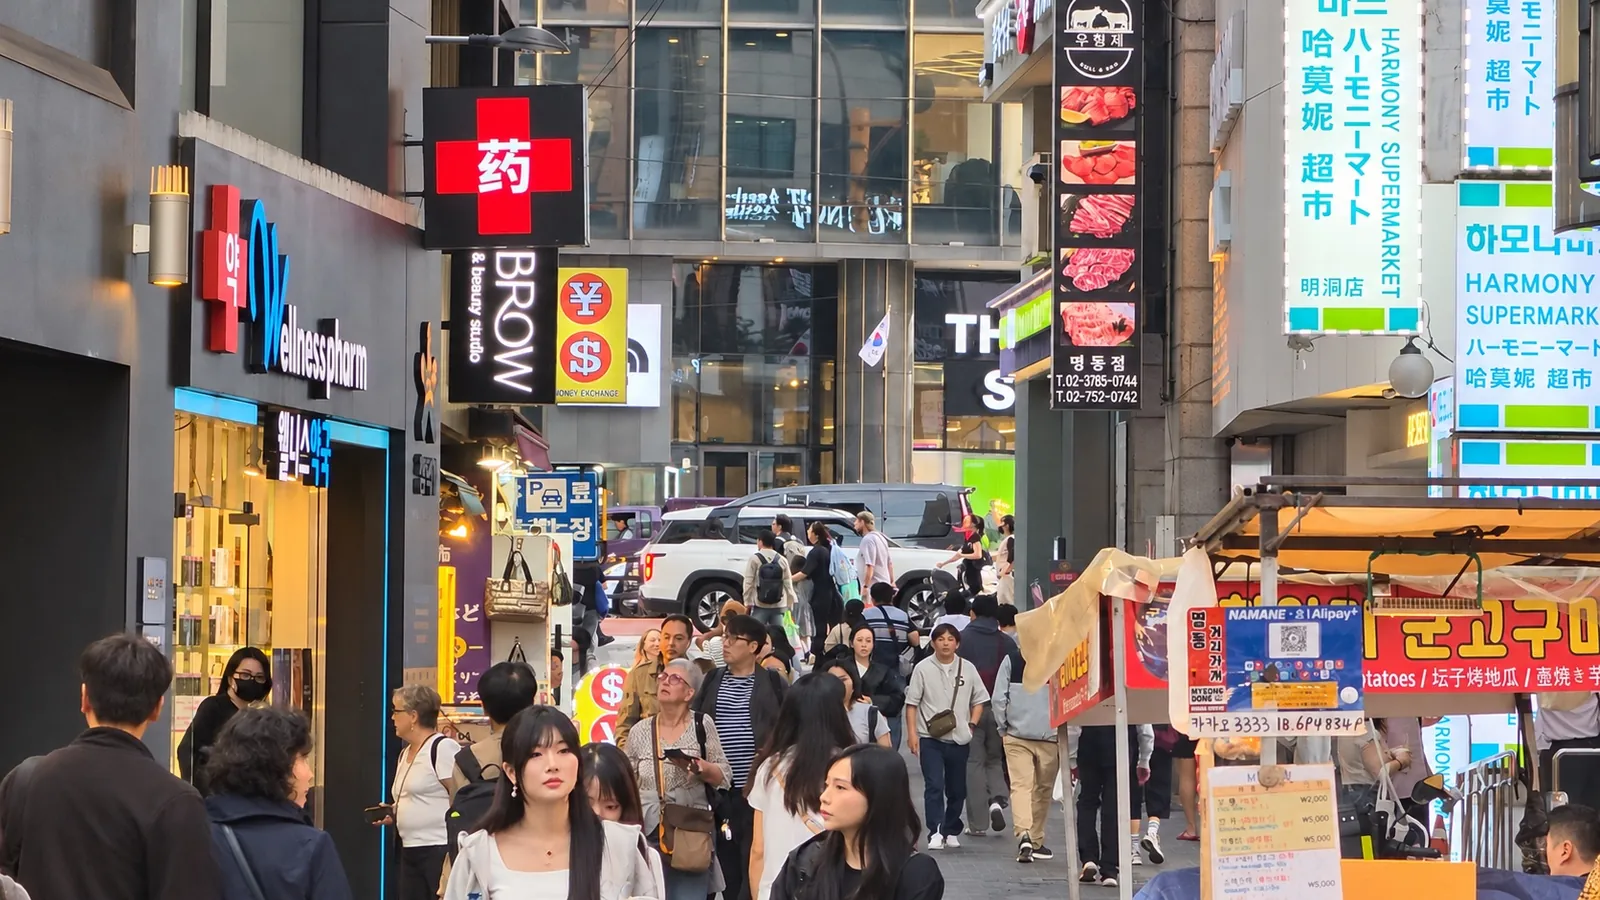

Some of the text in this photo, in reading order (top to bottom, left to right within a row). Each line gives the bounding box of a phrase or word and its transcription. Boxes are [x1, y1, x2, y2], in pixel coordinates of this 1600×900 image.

[1075, 33, 1123, 47] 우형제
[1485, 59, 1512, 111] 超市
[1301, 27, 1334, 220] 哈莫妮 超市
[1342, 27, 1372, 225] ハーモニーマート
[477, 138, 531, 194] 药
[1380, 27, 1401, 298] HARMONY SUPERMARKET
[471, 252, 486, 263] &
[225, 232, 241, 308] 약
[1300, 276, 1364, 297] 明洞店
[1465, 272, 1596, 295] HARMONY
[493, 251, 536, 393] BROW
[1465, 304, 1600, 326] SUPERMARK
[469, 318, 485, 364] studio
[1069, 354, 1125, 372] 명동점
[1056, 374, 1138, 388] T.02-3785-0744
[1465, 367, 1593, 390] 哈莫妮 超市
[580, 389, 620, 397] EXCHANGE
[1056, 390, 1138, 403] T.02-752-0742
[529, 481, 544, 496] P
[1228, 608, 1287, 621] NAMANE
[1191, 611, 1206, 649] 명동
[1363, 669, 1417, 687] tatoes
[1431, 666, 1519, 688] 坛子烤地瓜
[1191, 694, 1213, 703] DONG
[1191, 715, 1230, 732] 카카오
[1234, 716, 1271, 733] 3333
